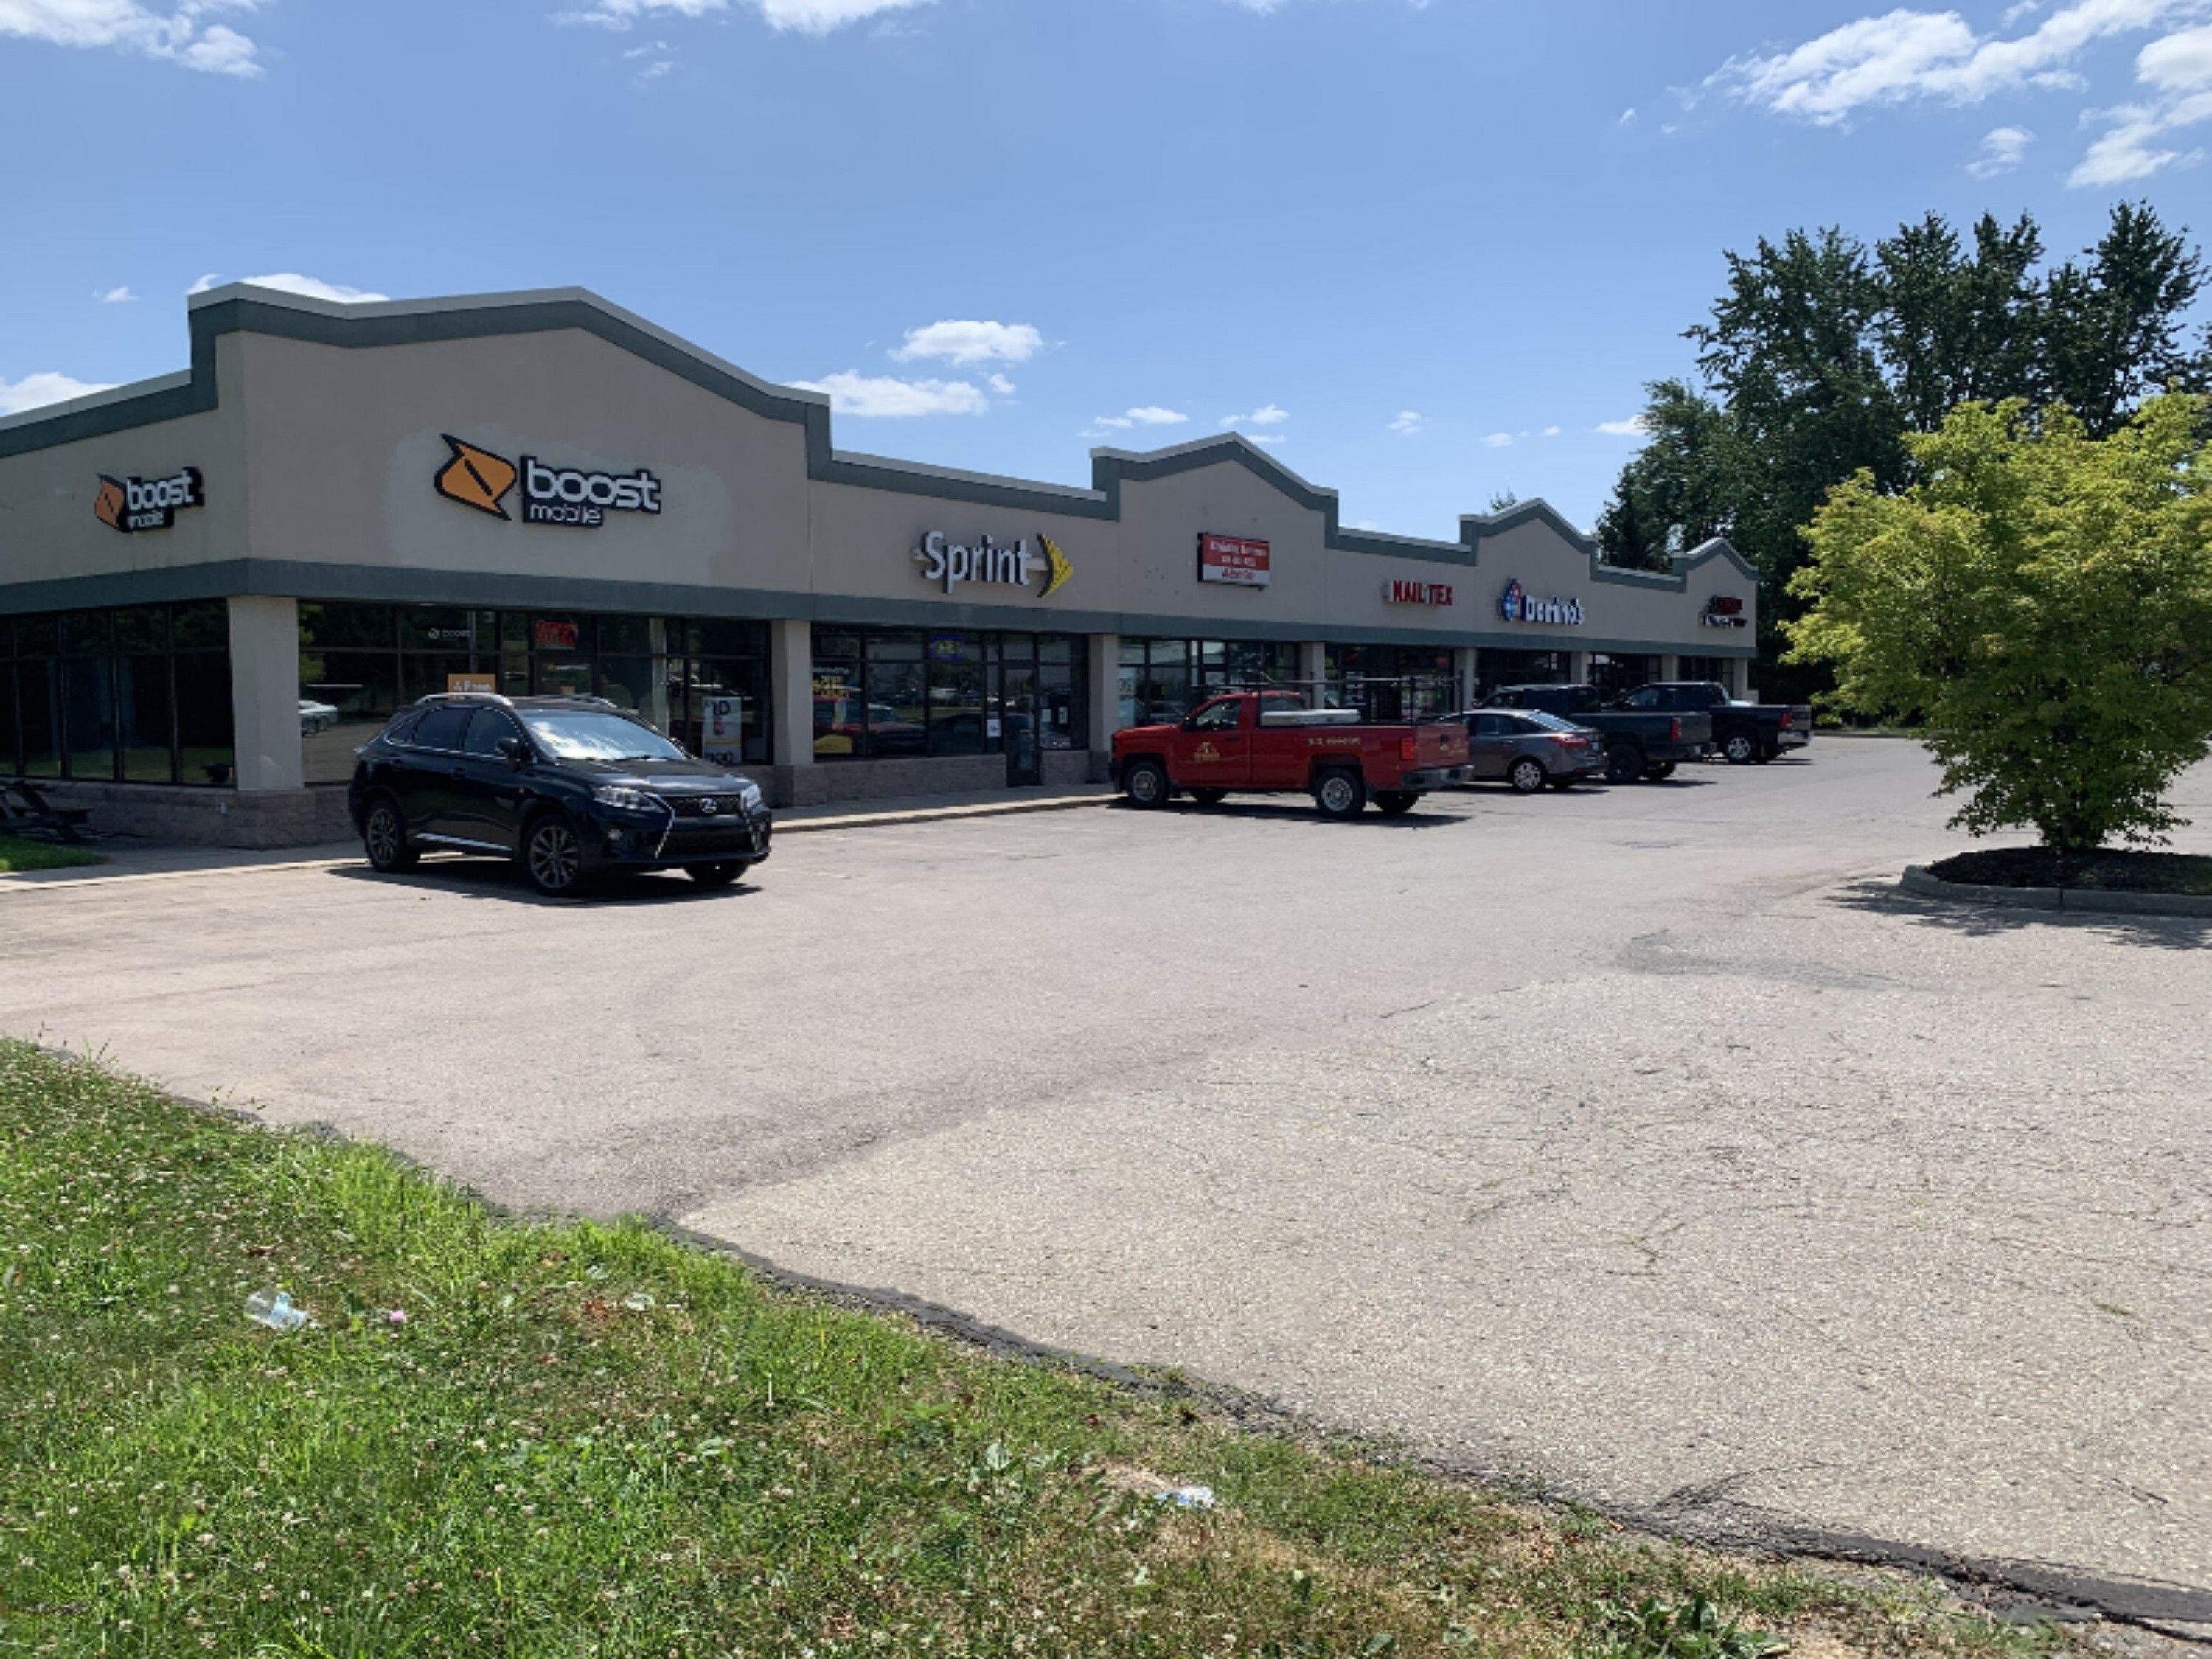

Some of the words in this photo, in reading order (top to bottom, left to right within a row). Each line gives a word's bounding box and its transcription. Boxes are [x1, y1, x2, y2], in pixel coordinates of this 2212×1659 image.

[126, 470, 195, 511] boost
[526, 459, 659, 511] boost
[529, 503, 601, 524] mobile
[923, 530, 1031, 594] Sprint
